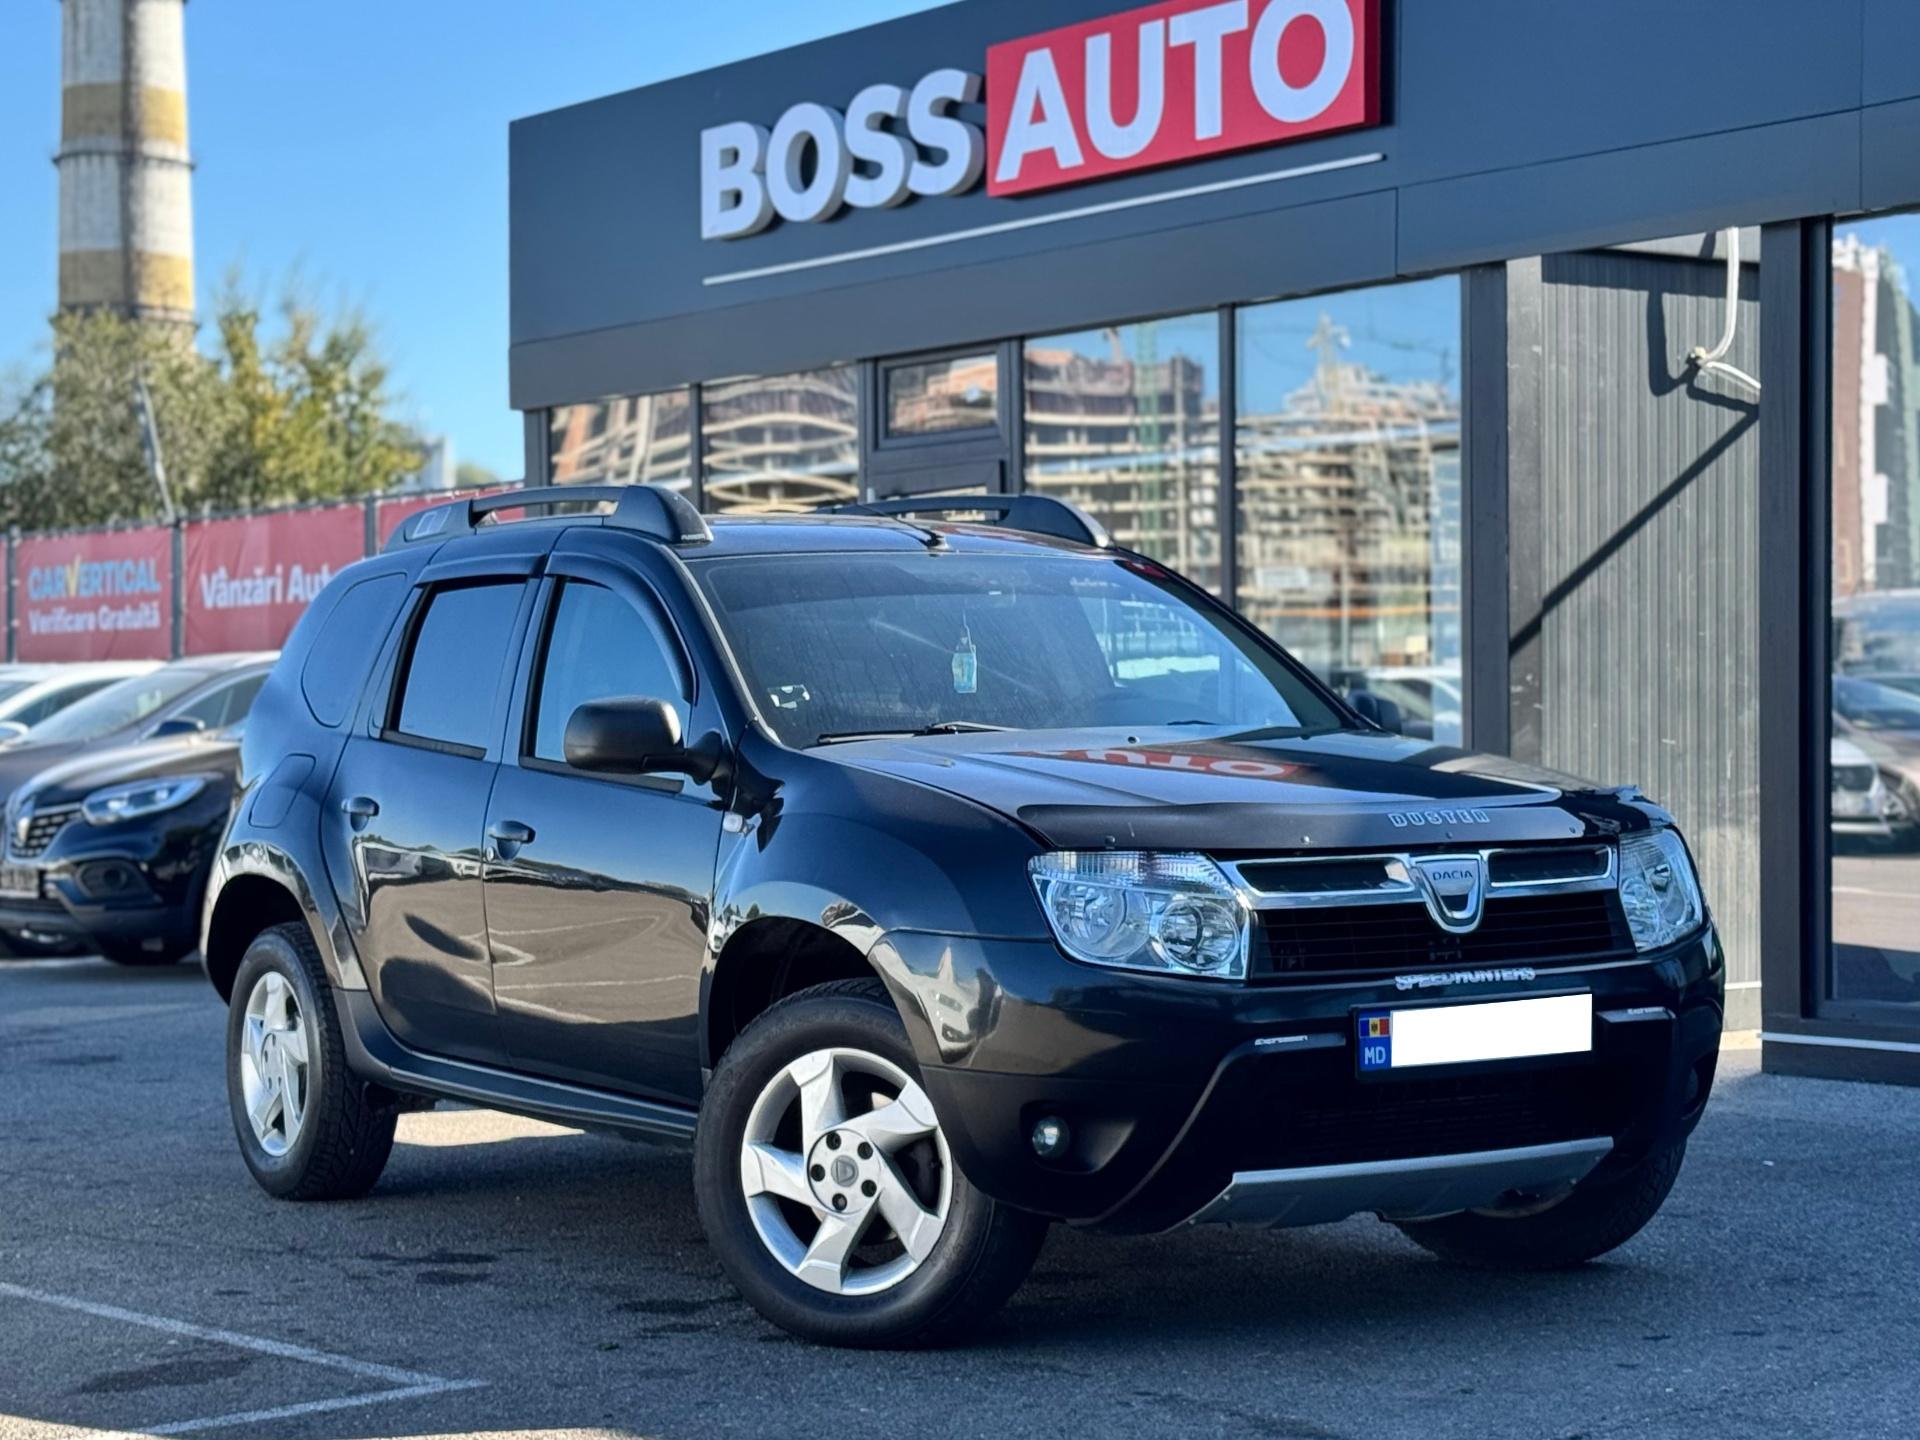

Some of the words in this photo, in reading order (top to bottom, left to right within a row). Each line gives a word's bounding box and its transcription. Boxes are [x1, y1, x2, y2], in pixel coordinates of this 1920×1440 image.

[700, 68, 986, 241] BOSS
[994, 0, 1356, 184] AUTO
[200, 564, 284, 610] Vânzări
[287, 563, 334, 603] Aut
[1387, 808, 1491, 828] DUSTER
[1432, 869, 1473, 881] DACIA
[1364, 1045, 1387, 1065] MD
